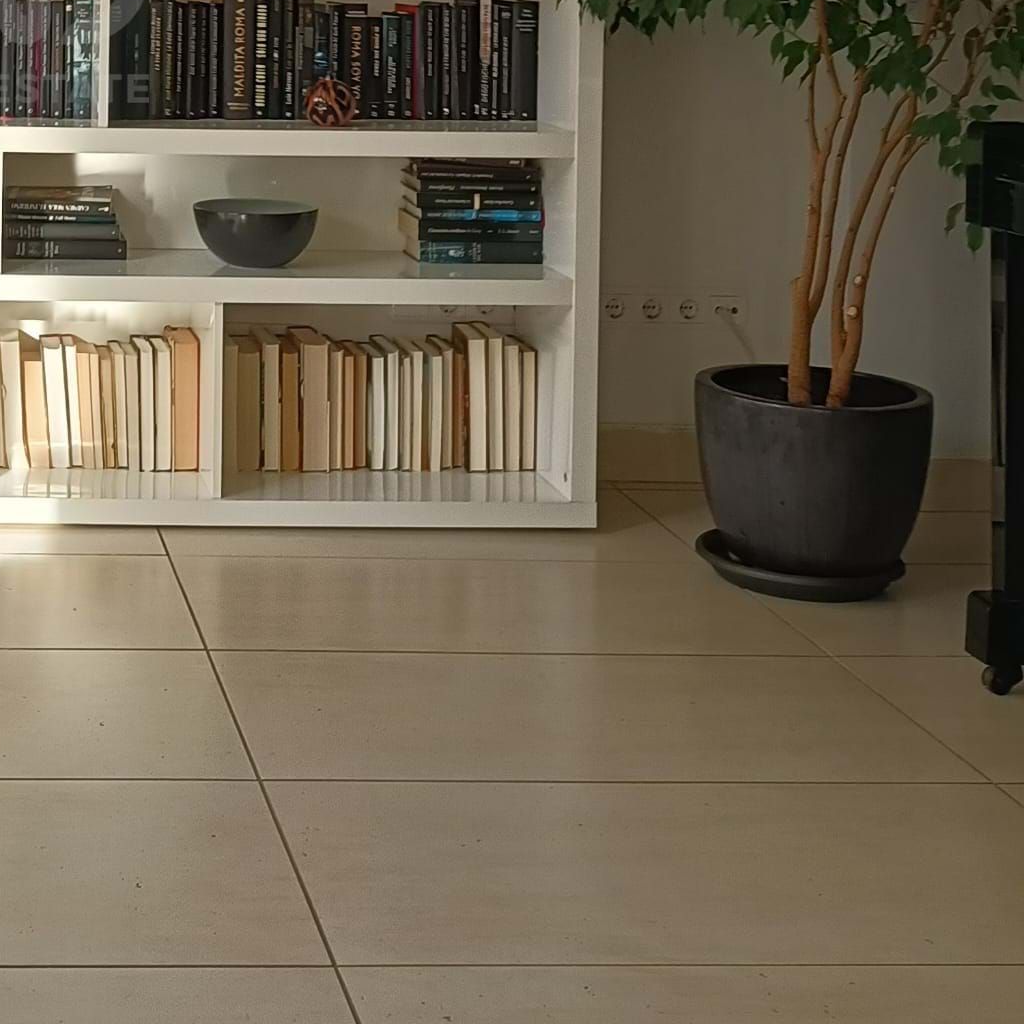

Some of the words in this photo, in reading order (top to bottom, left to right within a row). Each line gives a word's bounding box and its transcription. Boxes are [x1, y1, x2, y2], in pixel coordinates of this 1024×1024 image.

[234, 8, 246, 43] ROMA
[351, 26, 361, 58] ROMA
[234, 46, 245, 96] MALDITA
[351, 62, 361, 81] SOY
